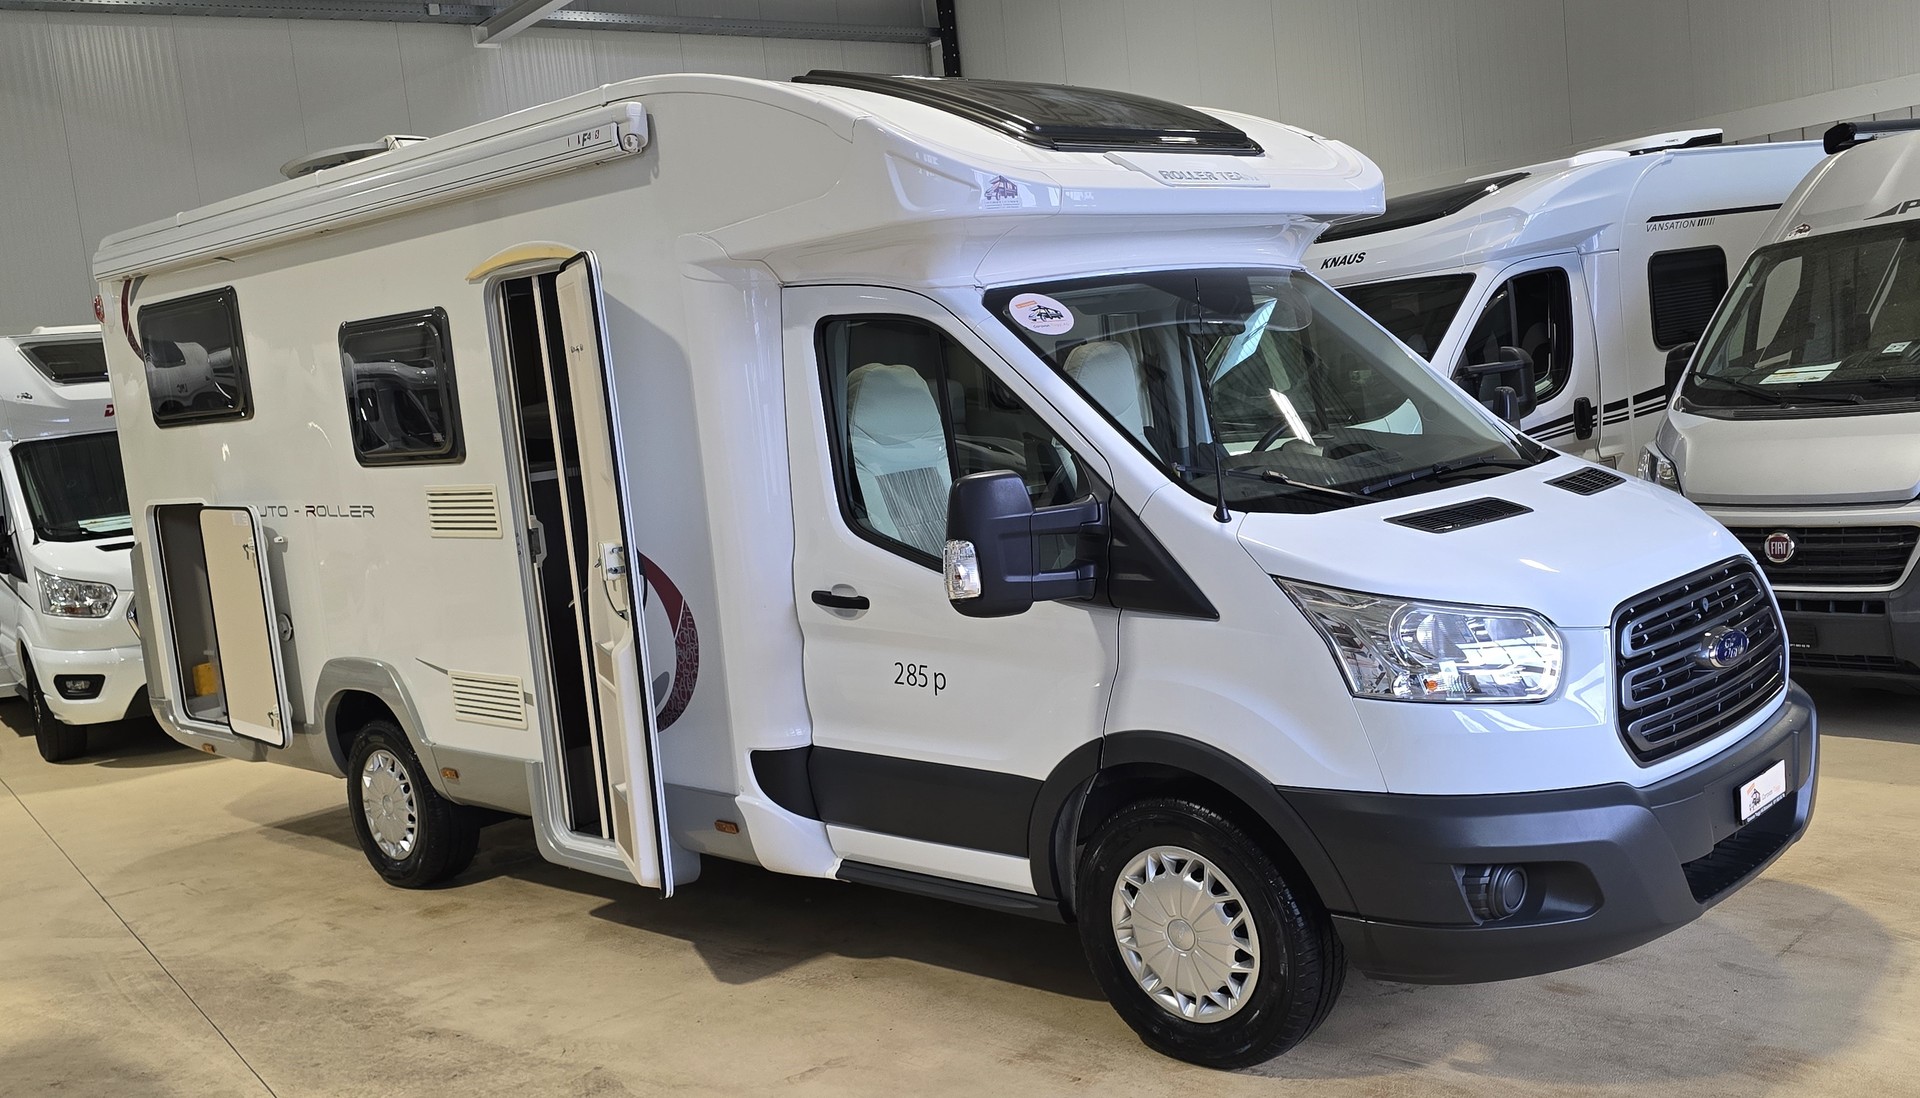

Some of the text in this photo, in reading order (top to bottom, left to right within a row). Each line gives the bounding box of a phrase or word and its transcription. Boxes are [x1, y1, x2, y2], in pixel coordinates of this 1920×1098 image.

[1158, 170, 1260, 181] ROLLER TEA
[1646, 219, 1697, 233] VANSATION
[1320, 251, 1367, 270] KNAUS
[257, 505, 288, 518] UTO
[304, 505, 375, 518] ROLLER
[1770, 541, 1788, 555] FIAT
[894, 661, 947, 697] 285 p
